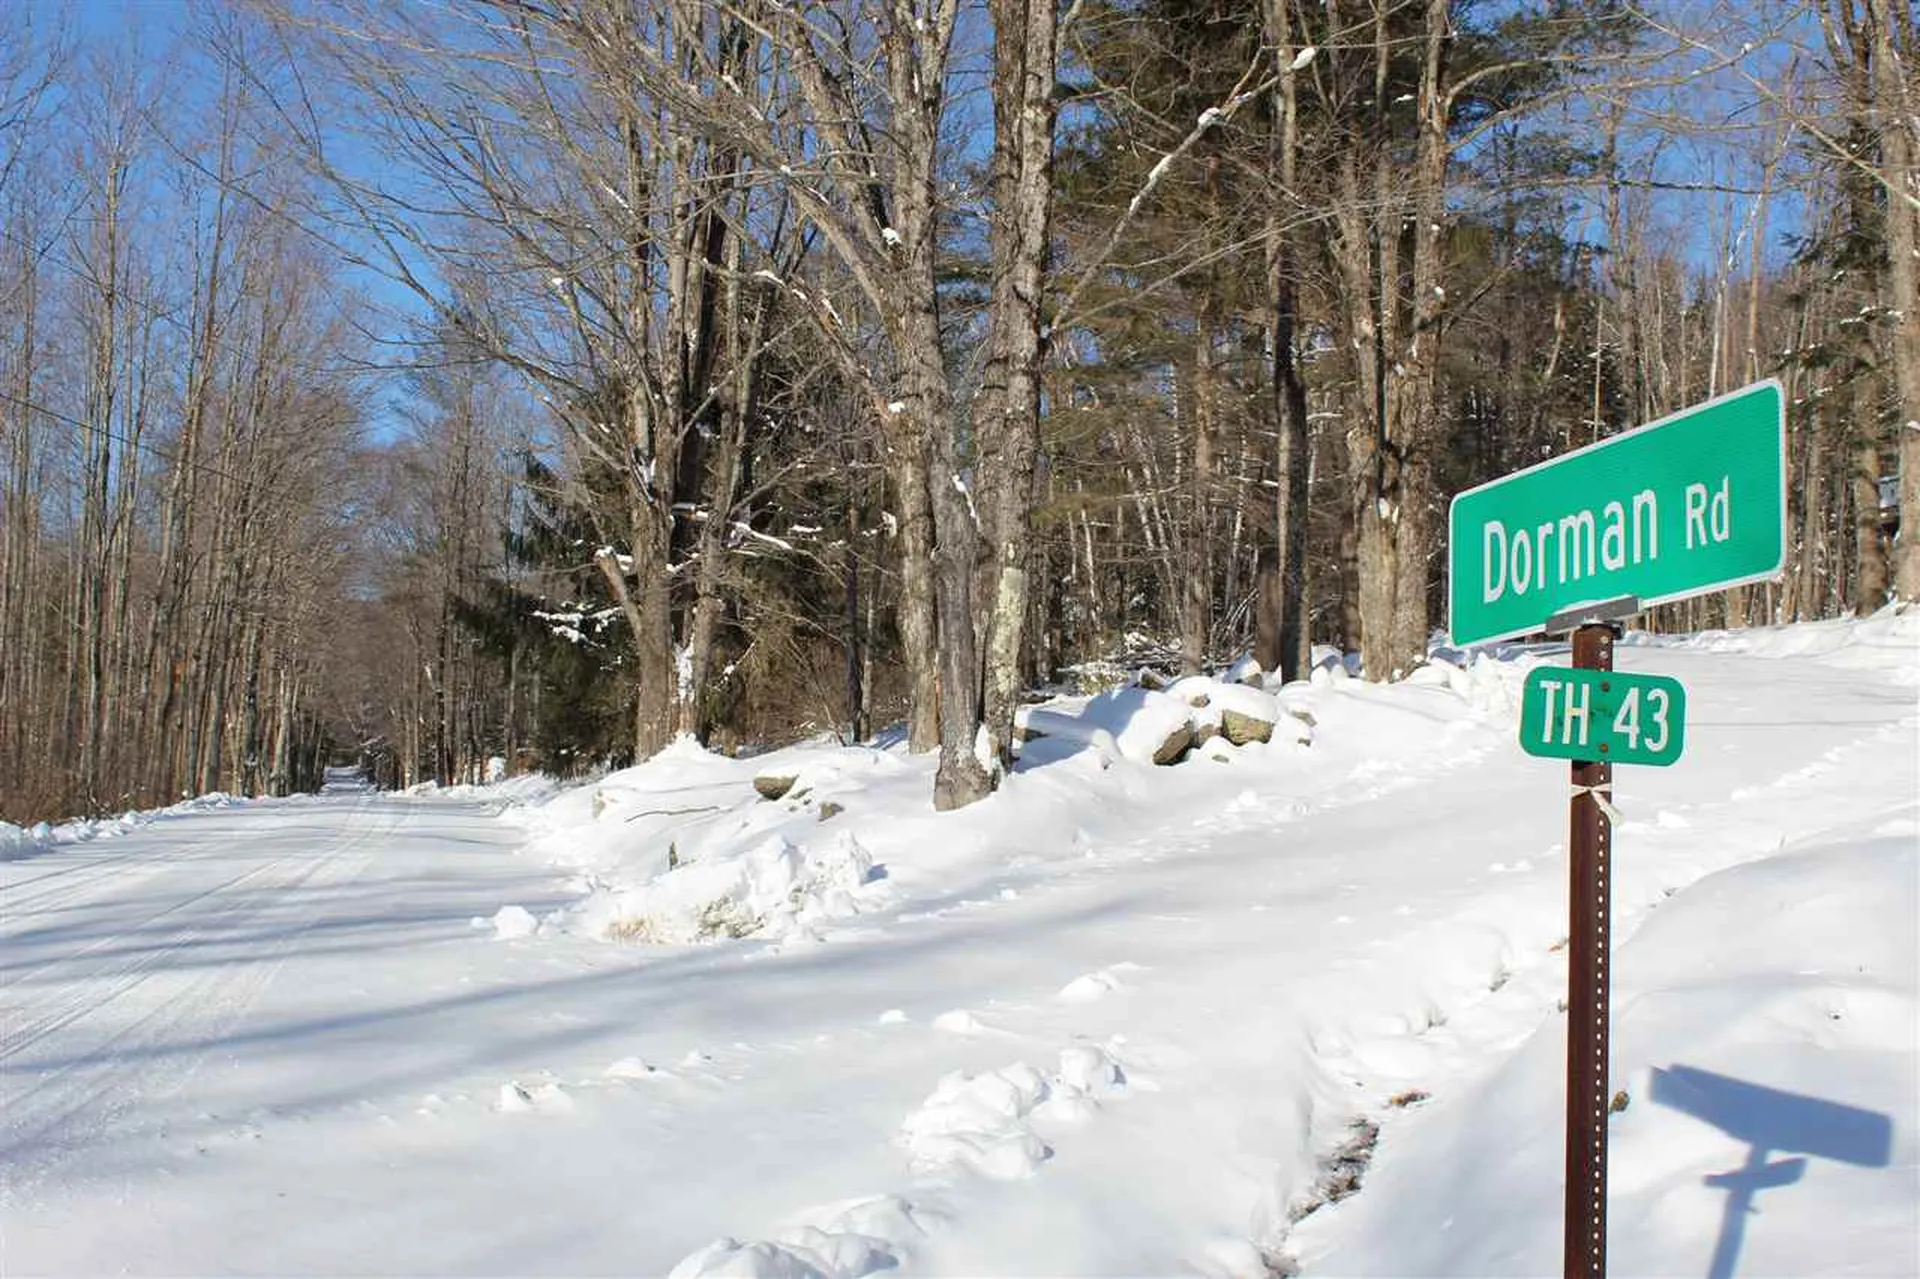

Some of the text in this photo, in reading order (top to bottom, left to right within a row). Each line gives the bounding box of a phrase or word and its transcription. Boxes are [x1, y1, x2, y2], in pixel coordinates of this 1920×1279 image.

[1483, 475, 1730, 604] Dorman Rd
[1540, 680, 1669, 753] TH 43
